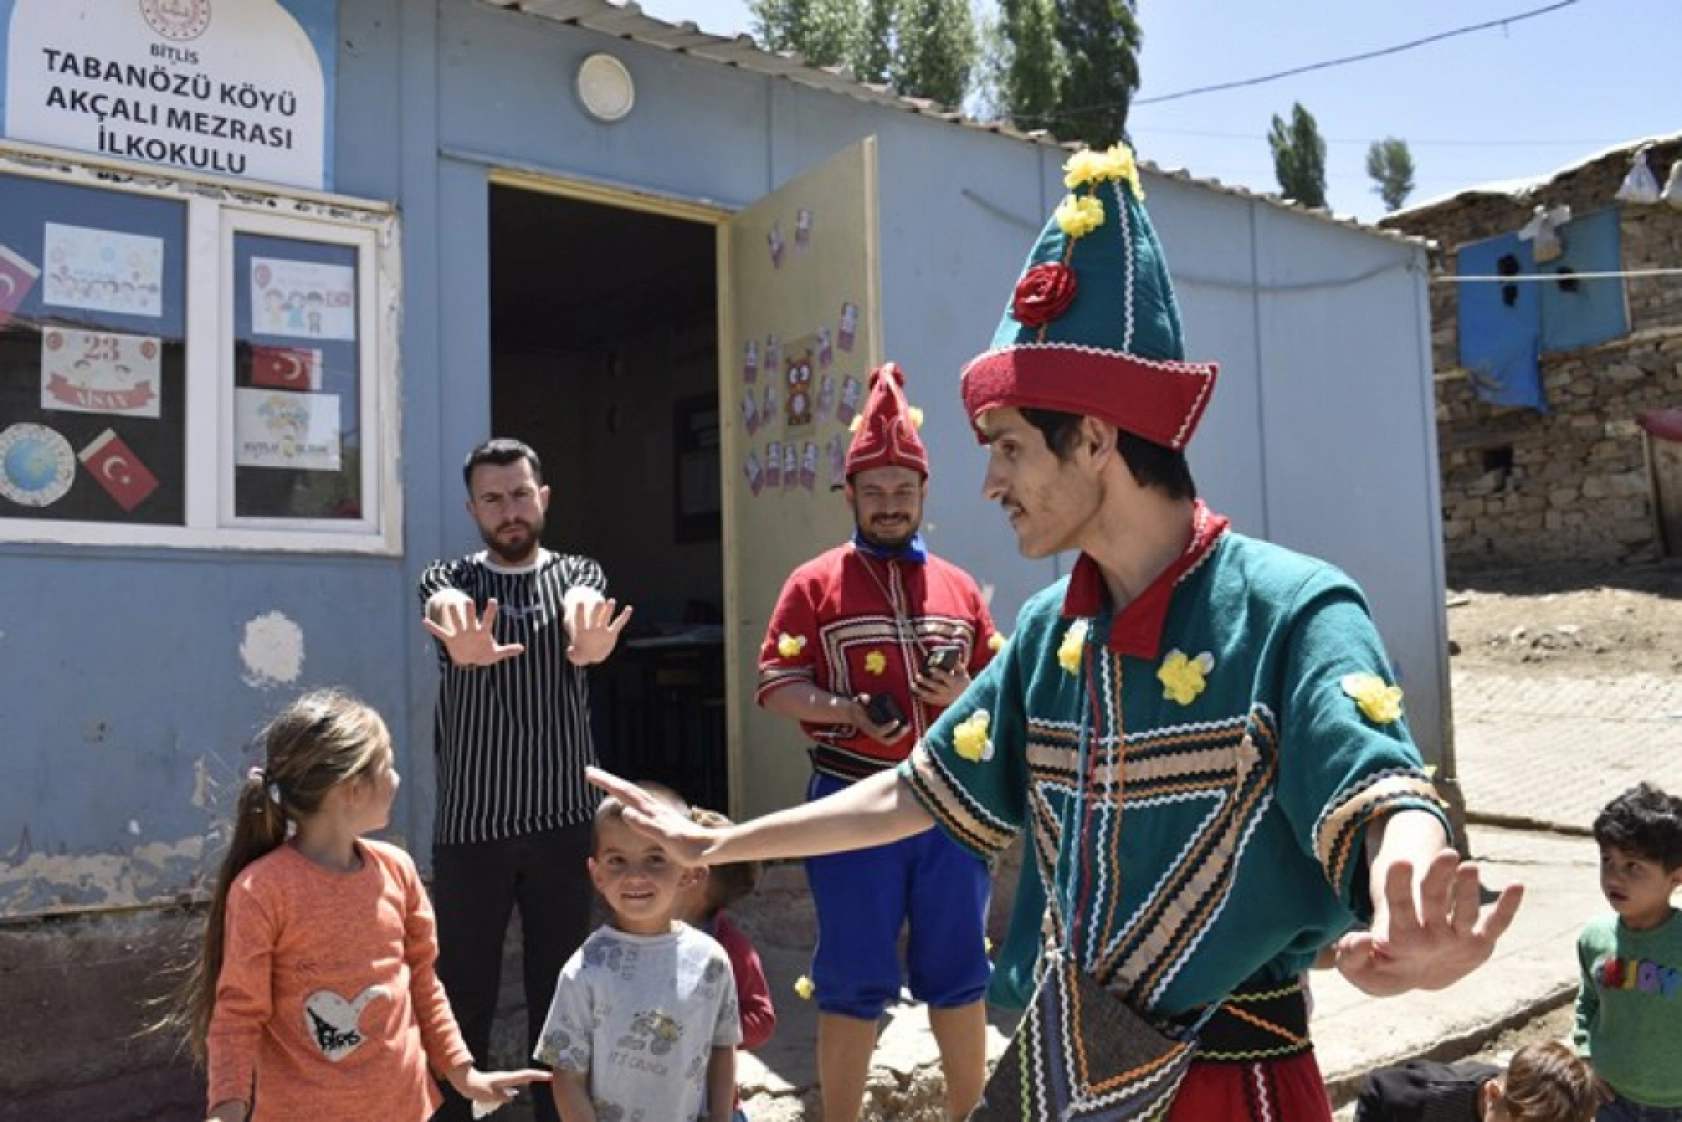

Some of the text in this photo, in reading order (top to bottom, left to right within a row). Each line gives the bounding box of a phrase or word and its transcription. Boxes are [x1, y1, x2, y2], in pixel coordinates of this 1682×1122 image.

[149, 43, 200, 65] BİTLİS
[42, 48, 297, 117] TABANÖZÜ KÖYÜ
[45, 86, 293, 150] AKÇALI MEZRASI
[98, 122, 247, 175] İLKOKULU
[84, 335, 120, 361] 23
